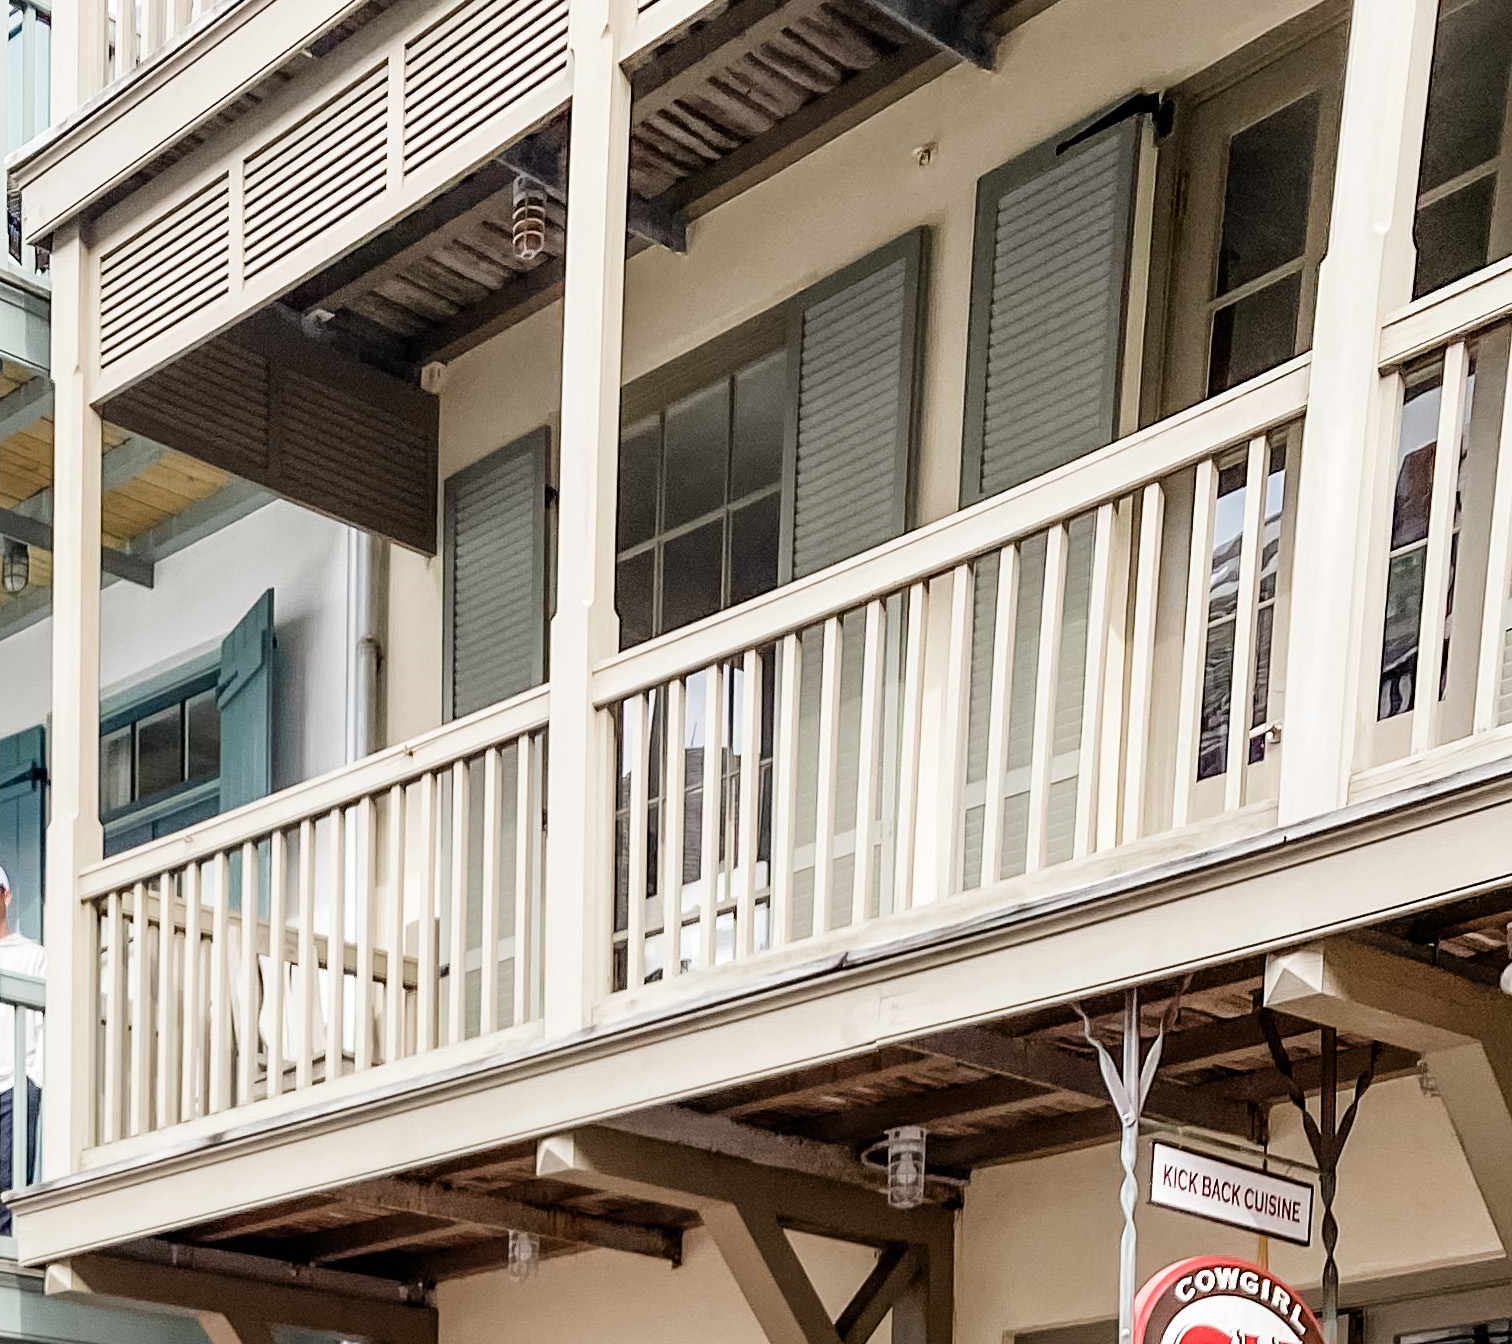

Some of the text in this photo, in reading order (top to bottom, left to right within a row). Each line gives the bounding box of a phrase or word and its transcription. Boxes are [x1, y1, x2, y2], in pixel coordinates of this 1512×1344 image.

[1163, 1164, 1302, 1223] KICK BACK CUISINE
[1174, 1266, 1308, 1336] COWGIRL
